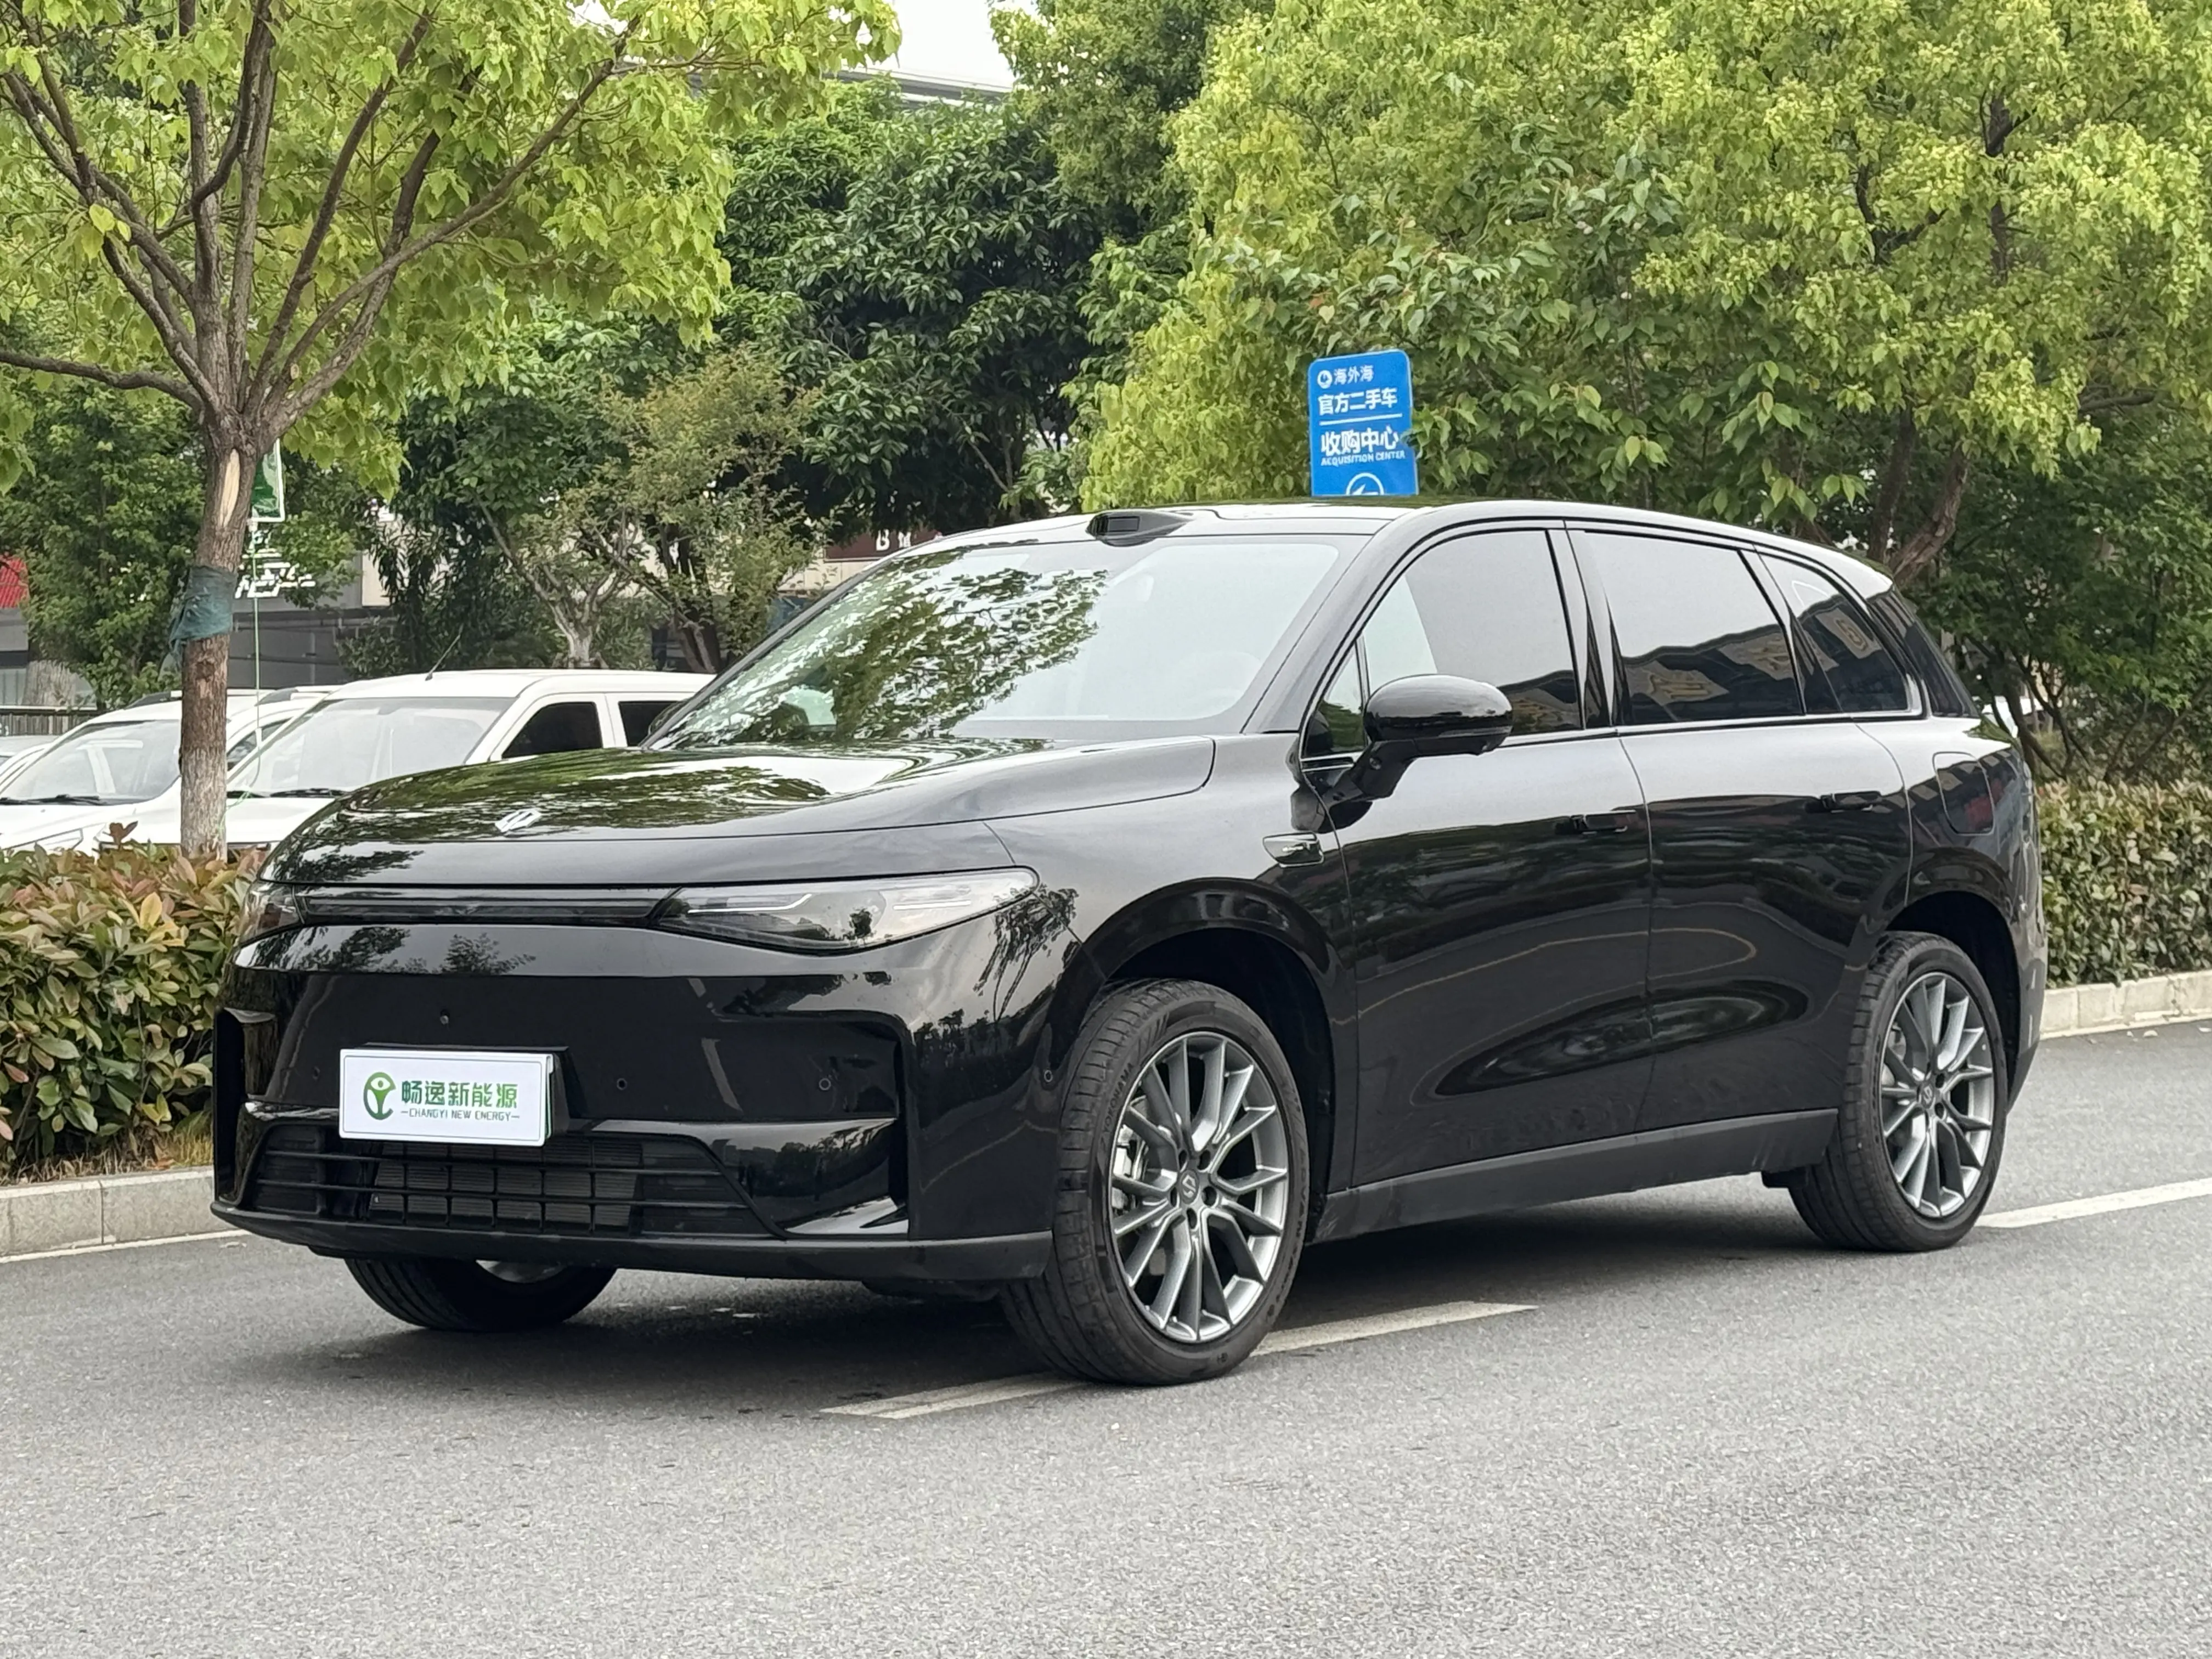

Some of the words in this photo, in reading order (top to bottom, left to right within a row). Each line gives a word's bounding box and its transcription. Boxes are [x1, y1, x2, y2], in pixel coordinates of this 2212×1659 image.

[1334, 365, 1374, 385] 海外海
[1318, 387, 1397, 415] 官方二手车
[1321, 425, 1398, 456] 收购中心
[1321, 453, 1374, 466] ACQUISITION
[1375, 450, 1406, 461] CENTER
[402, 1080, 518, 1108] 畅逸新能源
[451, 1110, 472, 1119] NEW
